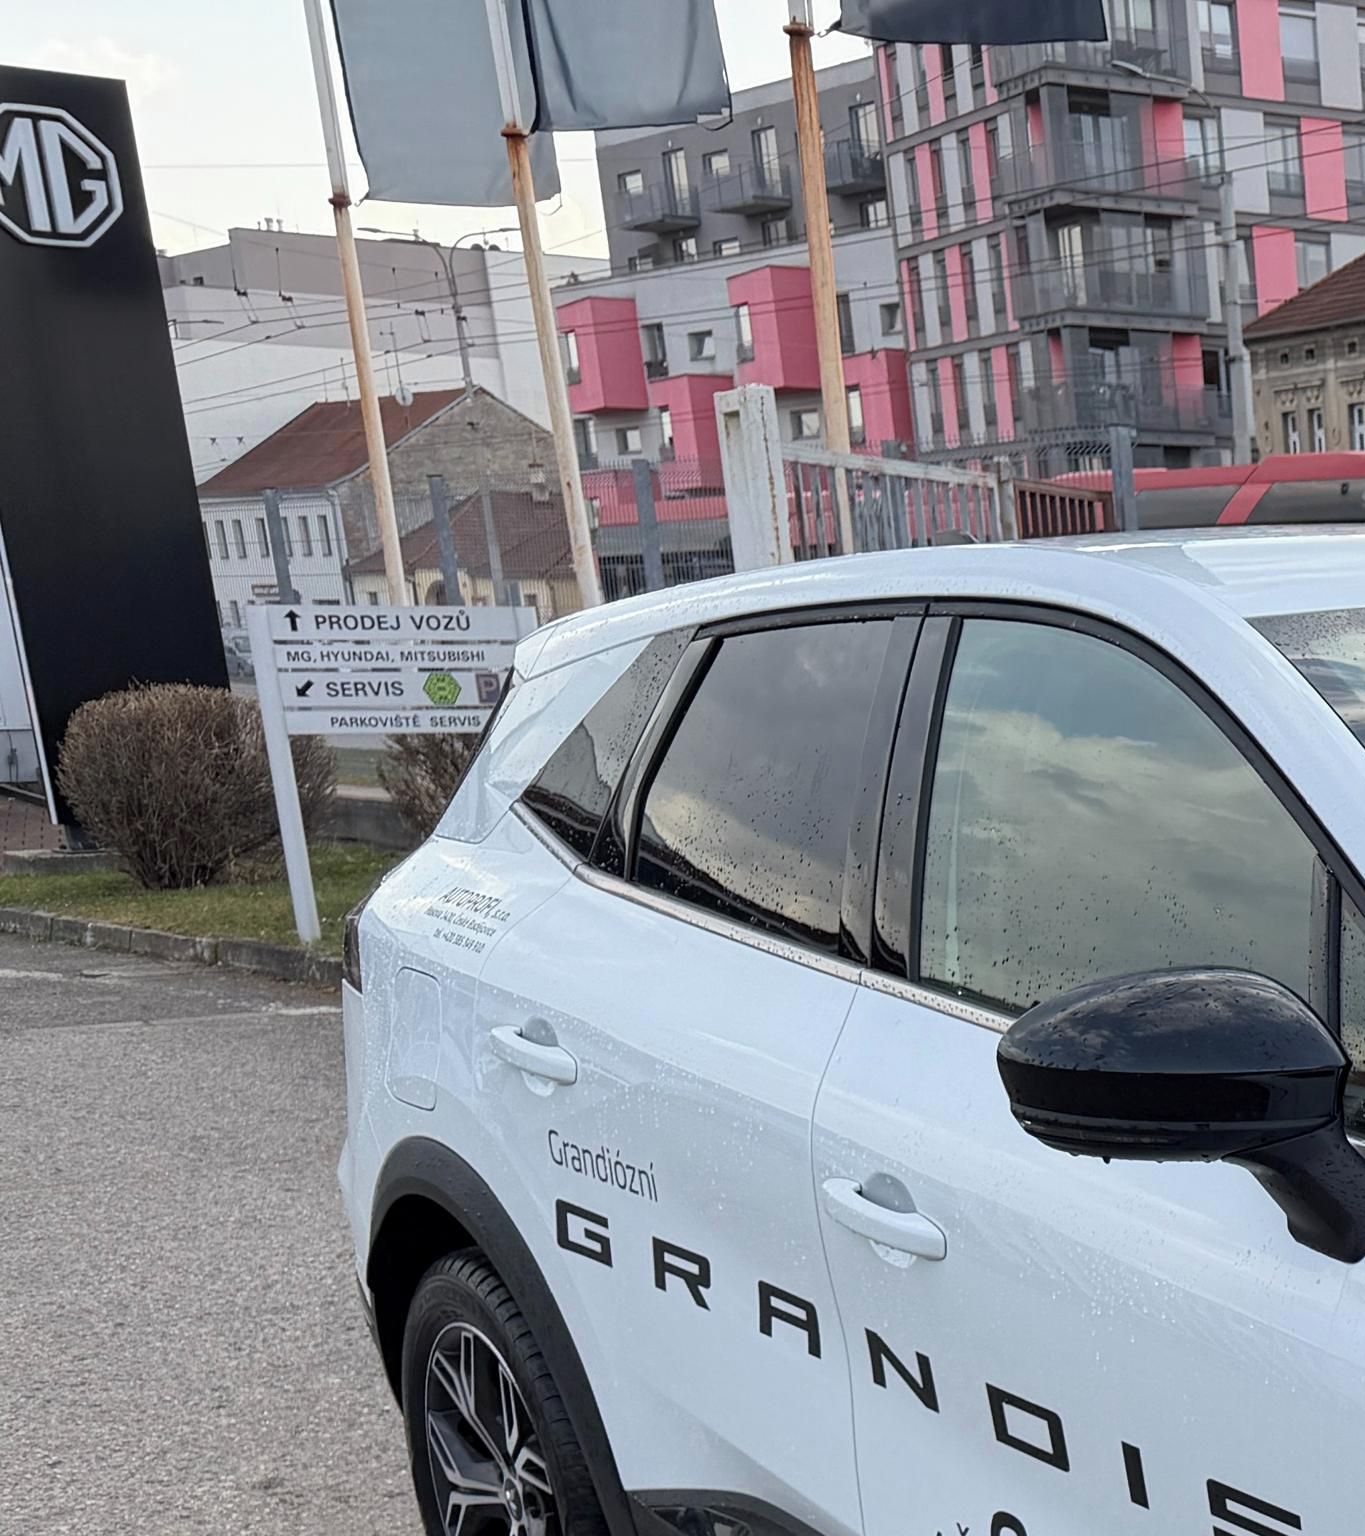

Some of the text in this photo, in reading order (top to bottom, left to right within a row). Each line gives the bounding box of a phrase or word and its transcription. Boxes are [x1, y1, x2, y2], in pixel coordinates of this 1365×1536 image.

[0, 117, 109, 235] MG
[314, 609, 471, 632] PRODEJ VOZŮ
[286, 650, 485, 664] MG, HYUNDAI, MITSUBISHI
[325, 676, 498, 701] SERVIS P
[330, 713, 482, 728] PARKOVIŠTĚ SERVIS
[547, 1129, 658, 1203] Grandiózní
